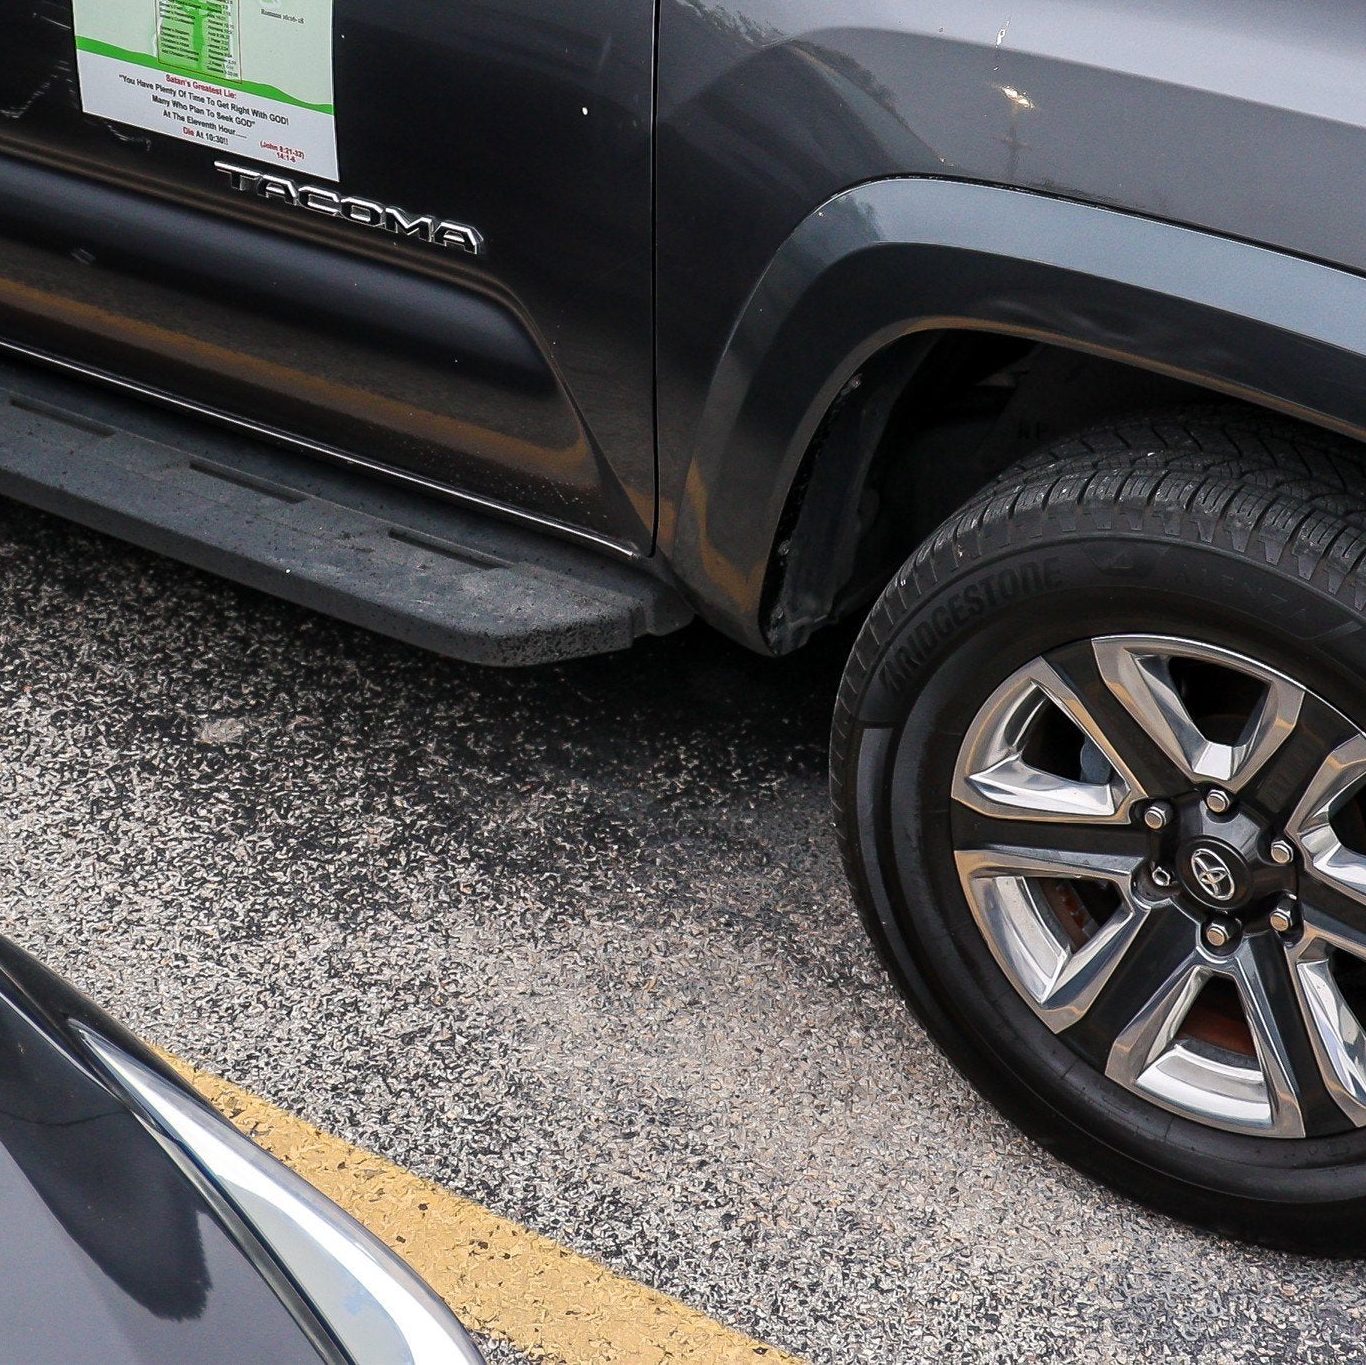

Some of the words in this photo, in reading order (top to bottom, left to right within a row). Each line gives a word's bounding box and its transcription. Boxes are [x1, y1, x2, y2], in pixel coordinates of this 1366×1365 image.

[165, 73, 190, 87] Satan's
[192, 80, 221, 96] Greatest
[223, 88, 236, 99] Lie:
[119, 74, 135, 84] "You
[136, 78, 153, 89] Have
[155, 83, 175, 97] Plenty
[178, 89, 186, 98] Of
[188, 91, 204, 103] Time
[206, 96, 214, 106] To
[216, 99, 229, 109] Get
[230, 102, 249, 115] Right
[250, 108, 267, 119] With
[269, 113, 288, 125] GOD!
[151, 94, 169, 107] Many
[171, 99, 187, 110] Who
[189, 104, 204, 115] Plan
[206, 108, 214, 117] To
[216, 111, 233, 123] Seek
[235, 116, 255, 128] GOD"
[163, 109, 170, 118] At
[172, 111, 184, 122] The
[186, 115, 216, 130] Eleventh
[182, 126, 194, 136] Die
[196, 129, 203, 139] At
[259, 140, 278, 151] (John
[213, 160, 485, 256] TACOMA
